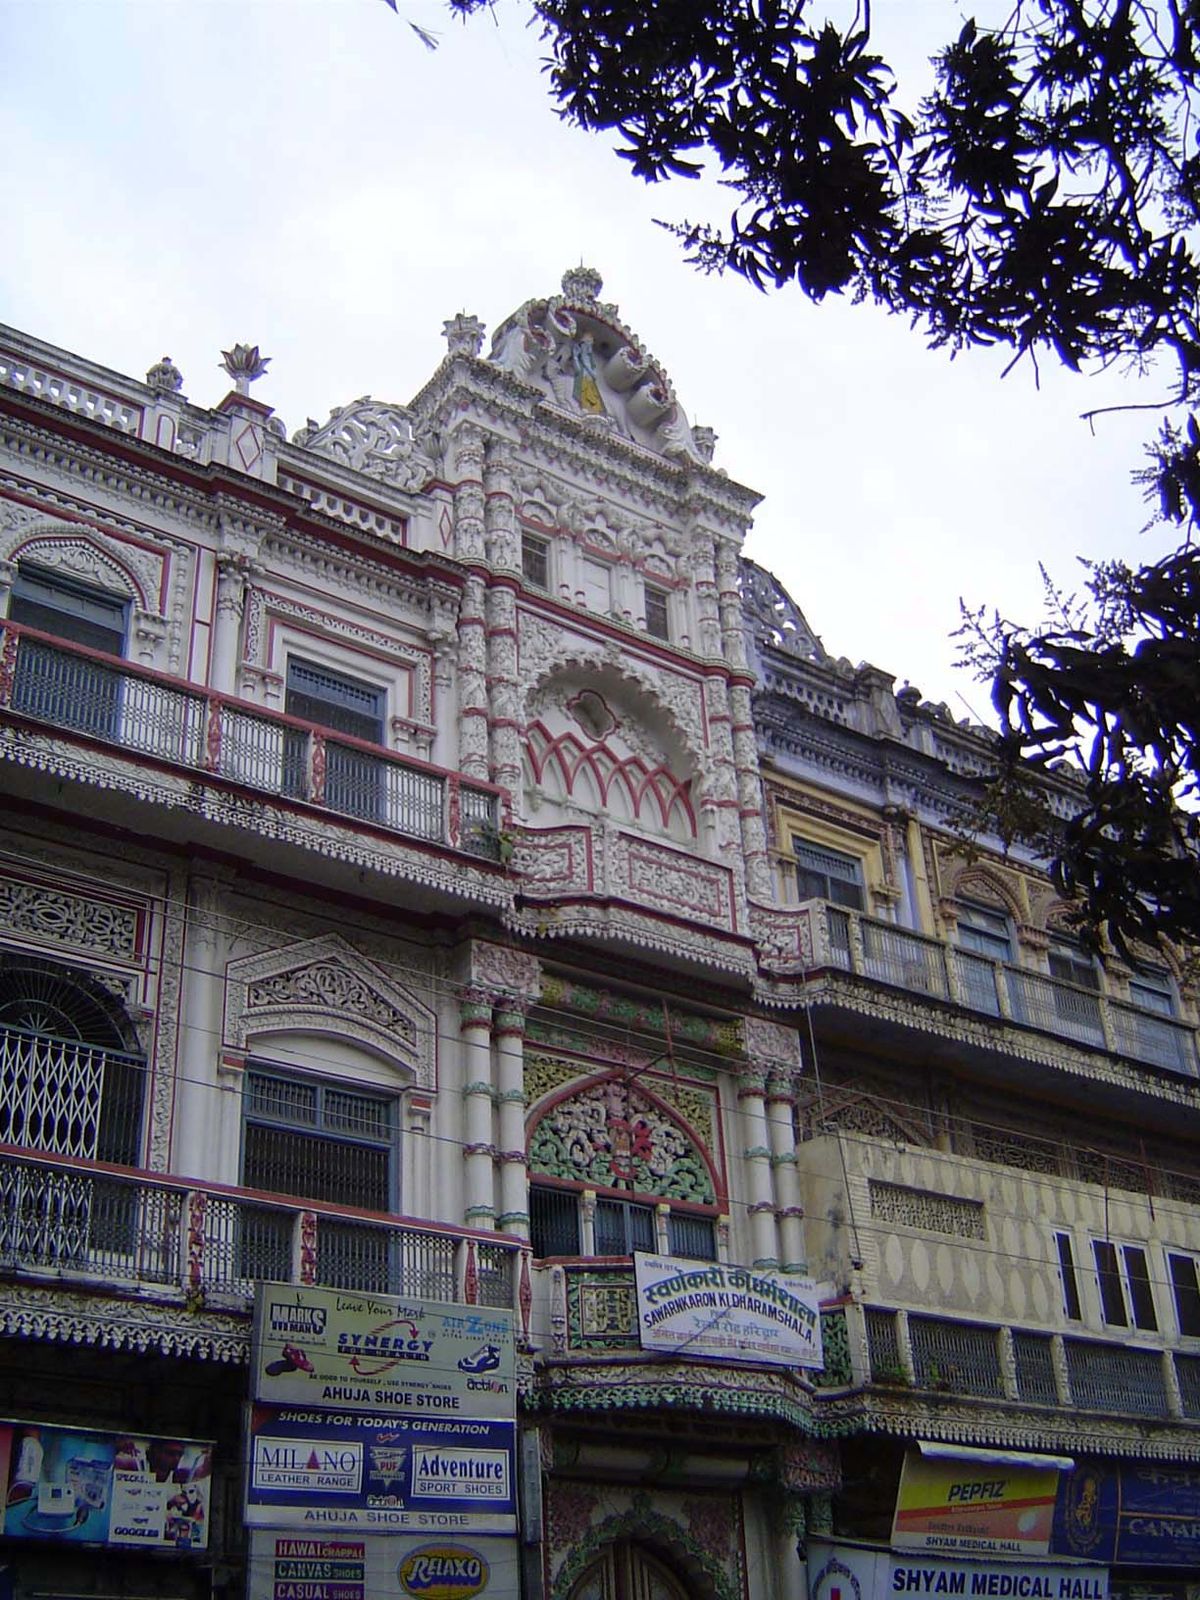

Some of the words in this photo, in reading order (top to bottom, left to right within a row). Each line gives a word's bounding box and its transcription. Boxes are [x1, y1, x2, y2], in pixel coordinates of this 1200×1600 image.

[642, 1266, 726, 1305] स्वर्णकारों
[727, 1269, 751, 1293] की
[752, 1276, 817, 1328] धर्मशाला
[270, 1303, 328, 1336] MARKS
[336, 1298, 364, 1313] Leave
[367, 1300, 394, 1316] Your
[397, 1304, 426, 1320] Mark
[643, 1292, 717, 1329] SAWARNKARON
[338, 1332, 434, 1353] SYNERGY
[466, 1378, 509, 1395] action
[322, 1386, 371, 1402] AHUJA
[375, 1390, 413, 1406] SHOE
[416, 1394, 460, 1409] STORE
[279, 1411, 323, 1424] SHOES
[326, 1415, 352, 1426] FOR
[356, 1417, 409, 1430] TODAY'S
[412, 1421, 490, 1435] GENERATION
[262, 1446, 357, 1473] MILANO
[418, 1454, 504, 1480] Adventure
[261, 1473, 310, 1485] LEATHER
[317, 1476, 354, 1487] RANGE
[419, 1481, 457, 1494] SPORT
[464, 1484, 503, 1495] SHOES
[947, 1481, 1007, 1501] PEPFIZ
[304, 1510, 358, 1521] AHUJA
[366, 1512, 410, 1524] SHOE
[418, 1514, 470, 1526] STORE
[114, 1526, 160, 1538] GOGGLES
[278, 1541, 322, 1556] HAWAI
[925, 1536, 958, 1548] SHYAM
[959, 1538, 998, 1550] MEDICAL
[999, 1542, 1022, 1552] HALL
[278, 1562, 332, 1579] CANVAS
[406, 1556, 481, 1583] RELAXO
[277, 1583, 331, 1600] CASUAL
[892, 1567, 966, 1594] SHYAM
[971, 1573, 1054, 1598] MEDICAL
[1059, 1577, 1103, 1600] HALL
